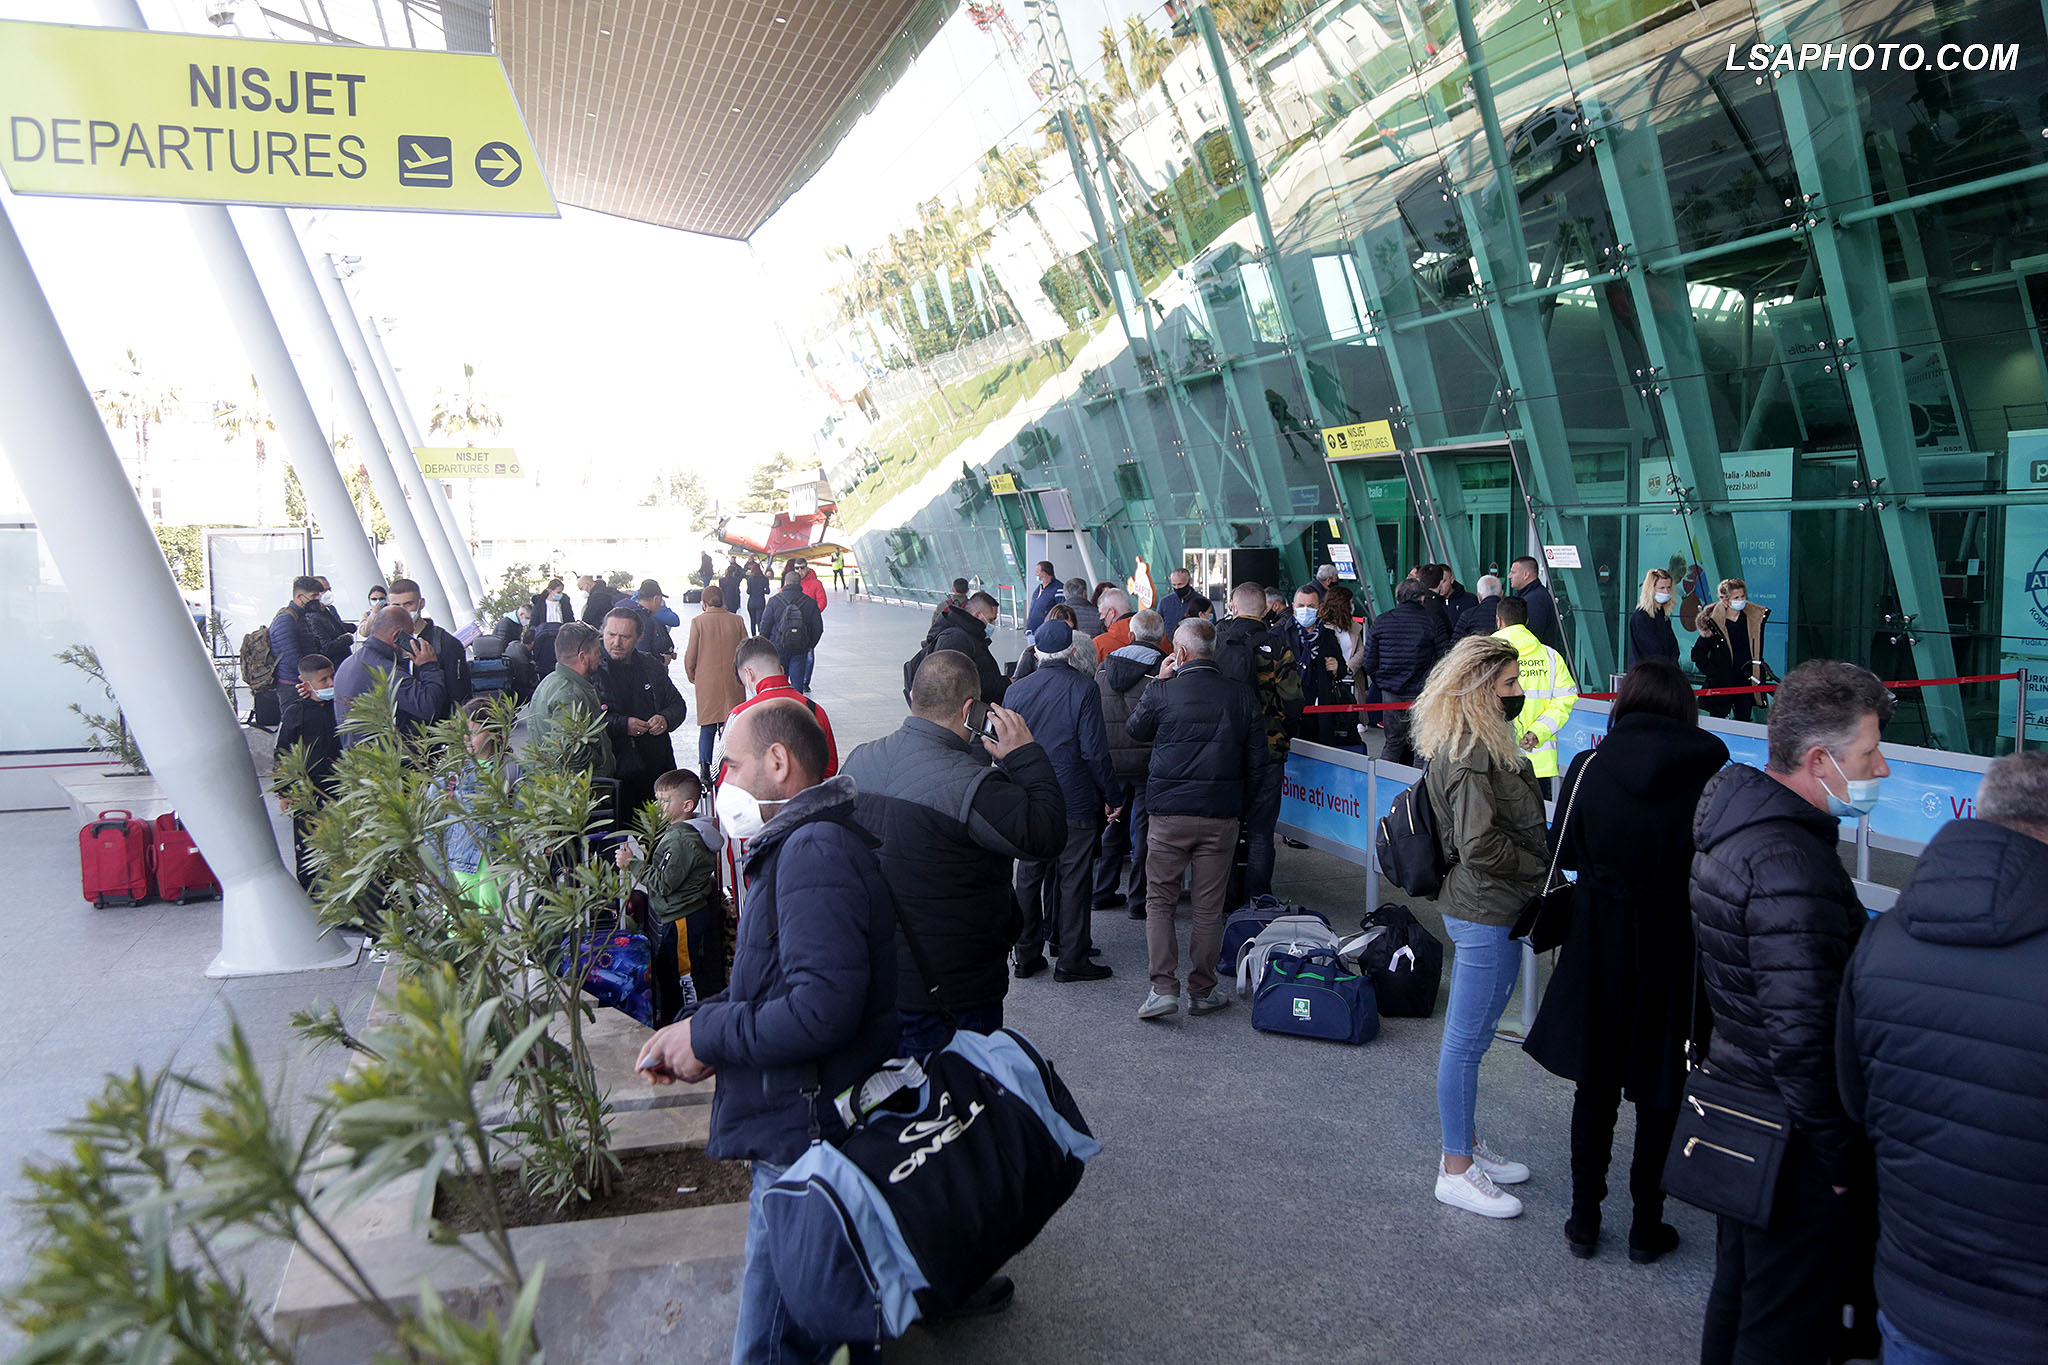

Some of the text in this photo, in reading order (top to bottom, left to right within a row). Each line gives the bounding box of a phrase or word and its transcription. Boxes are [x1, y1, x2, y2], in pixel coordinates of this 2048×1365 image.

[188, 63, 366, 117] NISJET
[10, 116, 368, 179] DEPARTURES
[1346, 426, 1368, 438] NISJET
[1350, 436, 1390, 451] DEPARTURES
[456, 452, 490, 461] NISJET
[424, 464, 490, 473] DEPARTURES
[1744, 468, 1771, 478] Albania
[1742, 480, 1759, 490] bassi
[1750, 538, 1775, 552] pranë
[1759, 554, 1777, 568] tuaj
[2029, 607, 2048, 631] KOMP
[1282, 775, 1306, 801] Bine
[1327, 794, 1360, 818] venit
[1950, 796, 1977, 820] Vi
